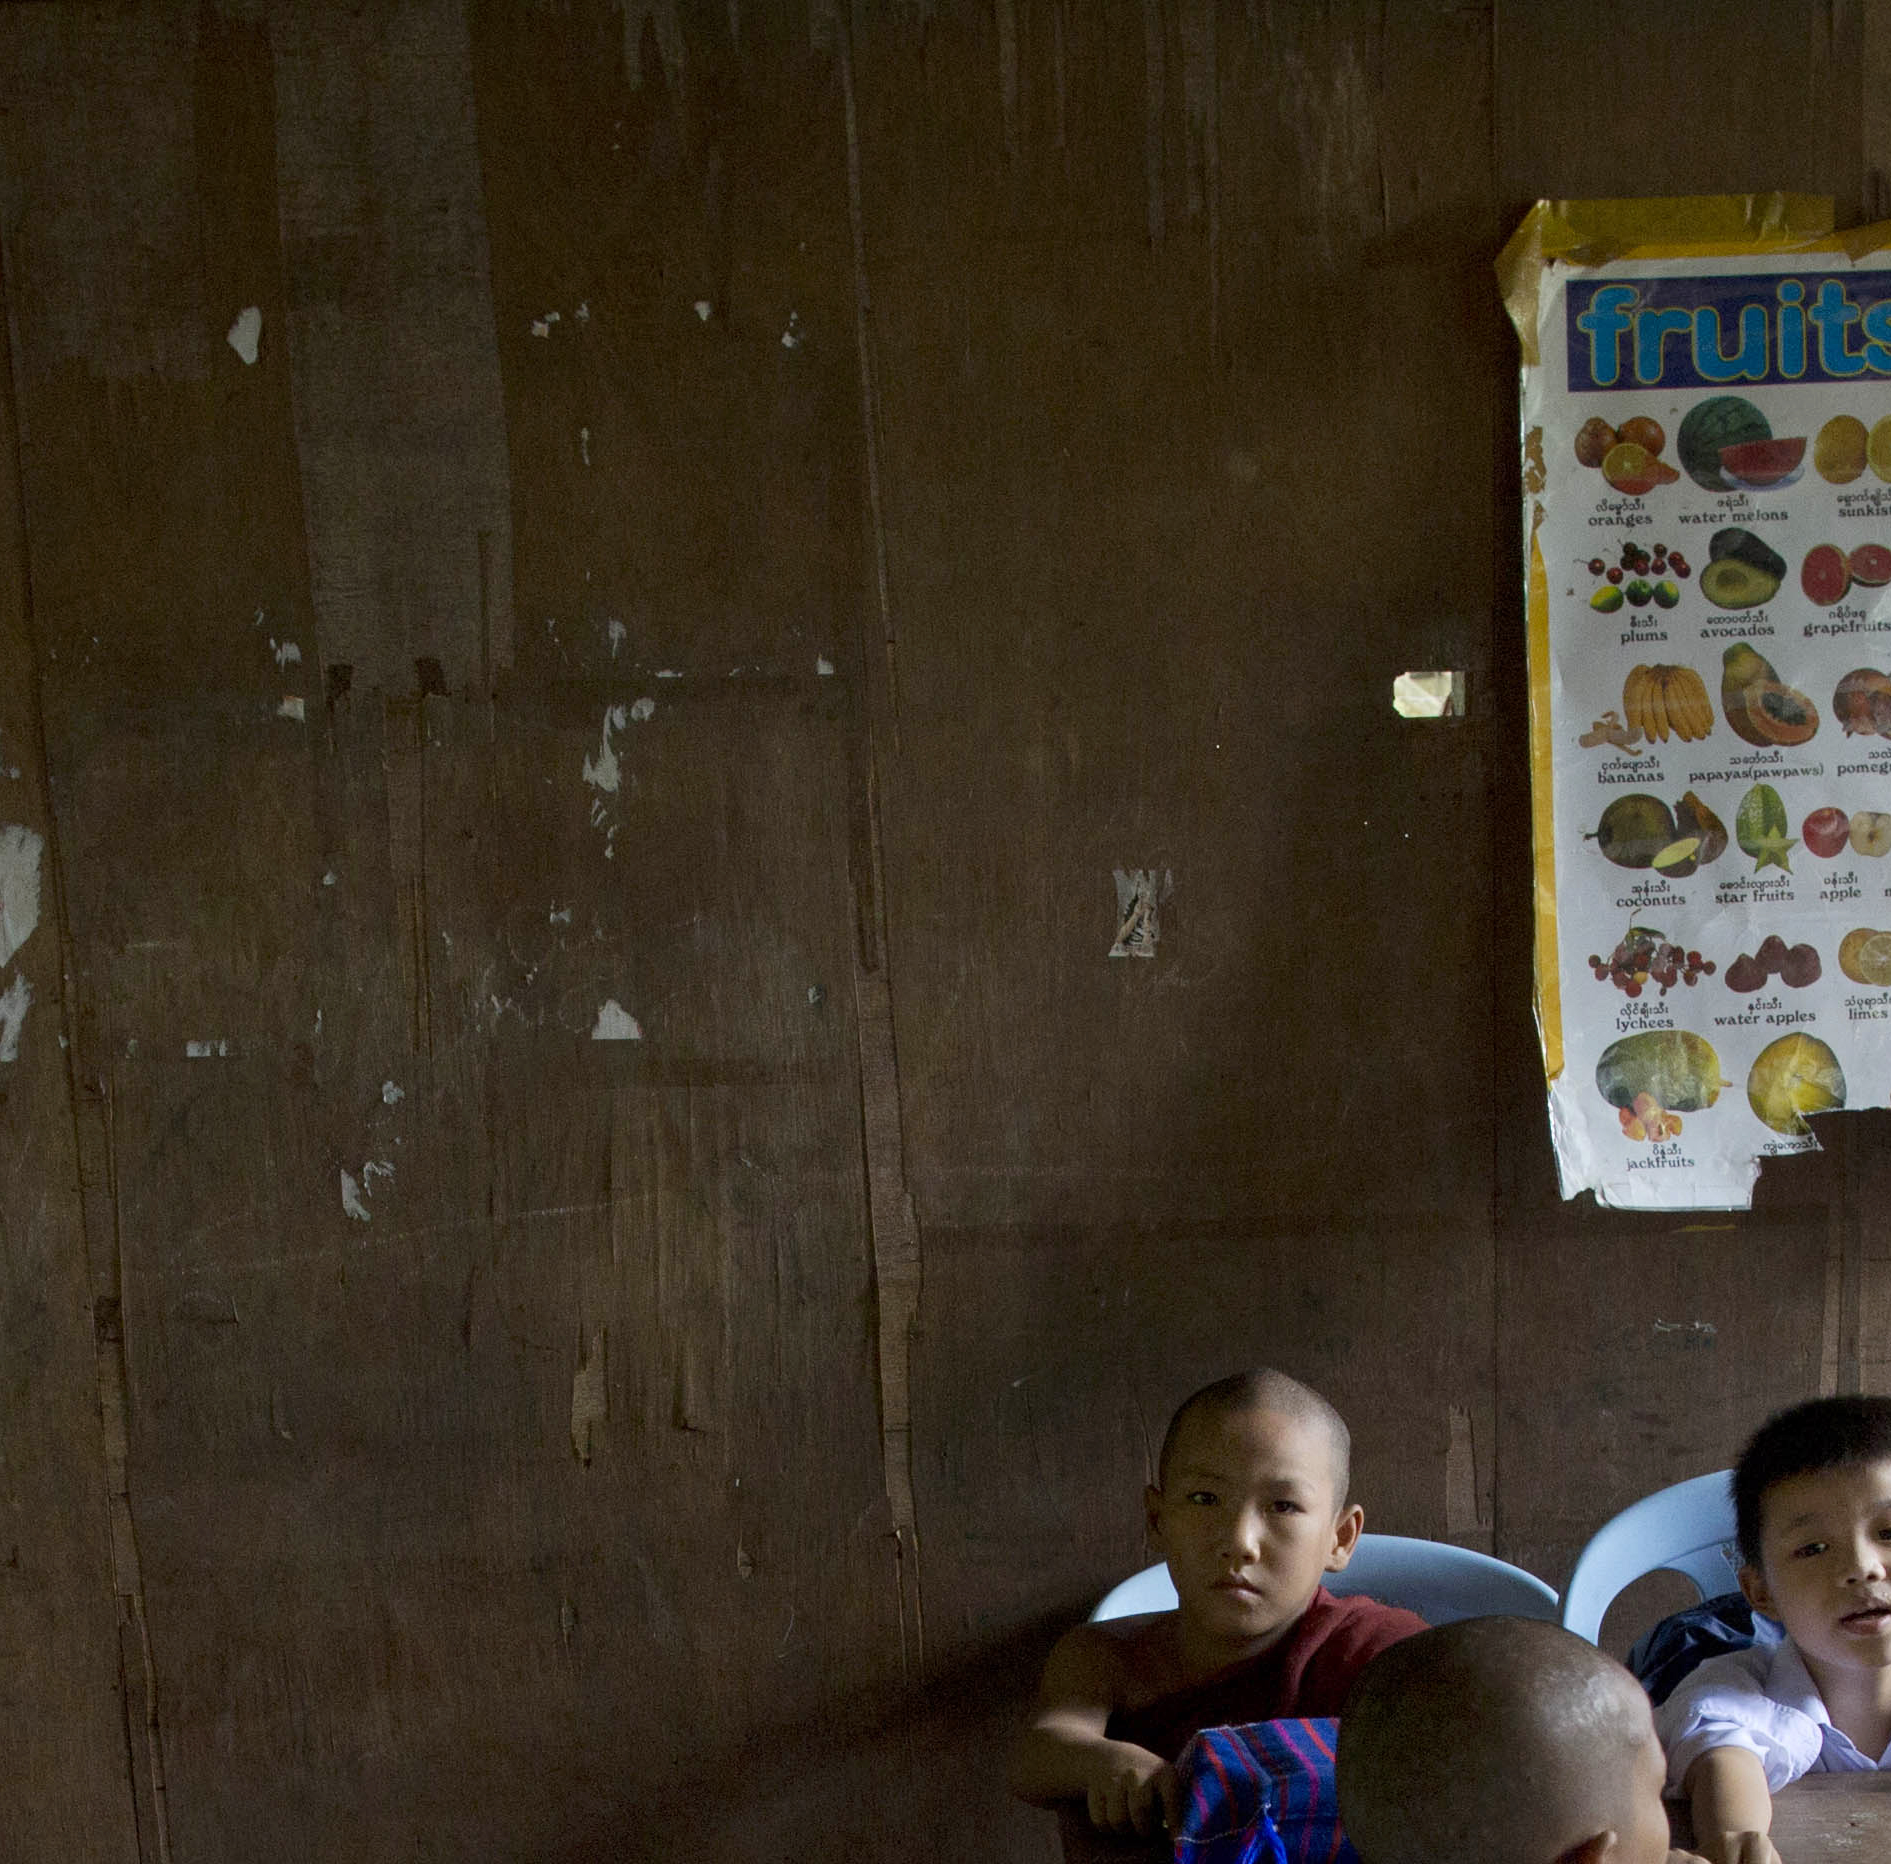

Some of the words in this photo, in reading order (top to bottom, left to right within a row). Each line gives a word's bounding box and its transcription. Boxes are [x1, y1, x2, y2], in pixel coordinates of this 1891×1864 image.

[1588, 513, 1653, 528] oranges
[1678, 512, 1727, 525] water
[1731, 509, 1789, 523] melons
[1700, 623, 1775, 639] avocados
[1803, 619, 1891, 638] grapefruits
[1620, 630, 1668, 646] plums
[1597, 770, 1665, 784] bananas
[1688, 762, 1825, 784] papayas(pawpaws)
[1616, 893, 1687, 908] coconuts
[1715, 891, 1747, 905] star
[1752, 888, 1795, 903] fruits
[1819, 885, 1862, 903] apple
[1713, 1012, 1760, 1027] water
[1765, 1010, 1817, 1027] apples
[1848, 1007, 1889, 1021] limes
[1616, 1016, 1675, 1034] lychees
[1625, 1156, 1696, 1172] jackfruits
